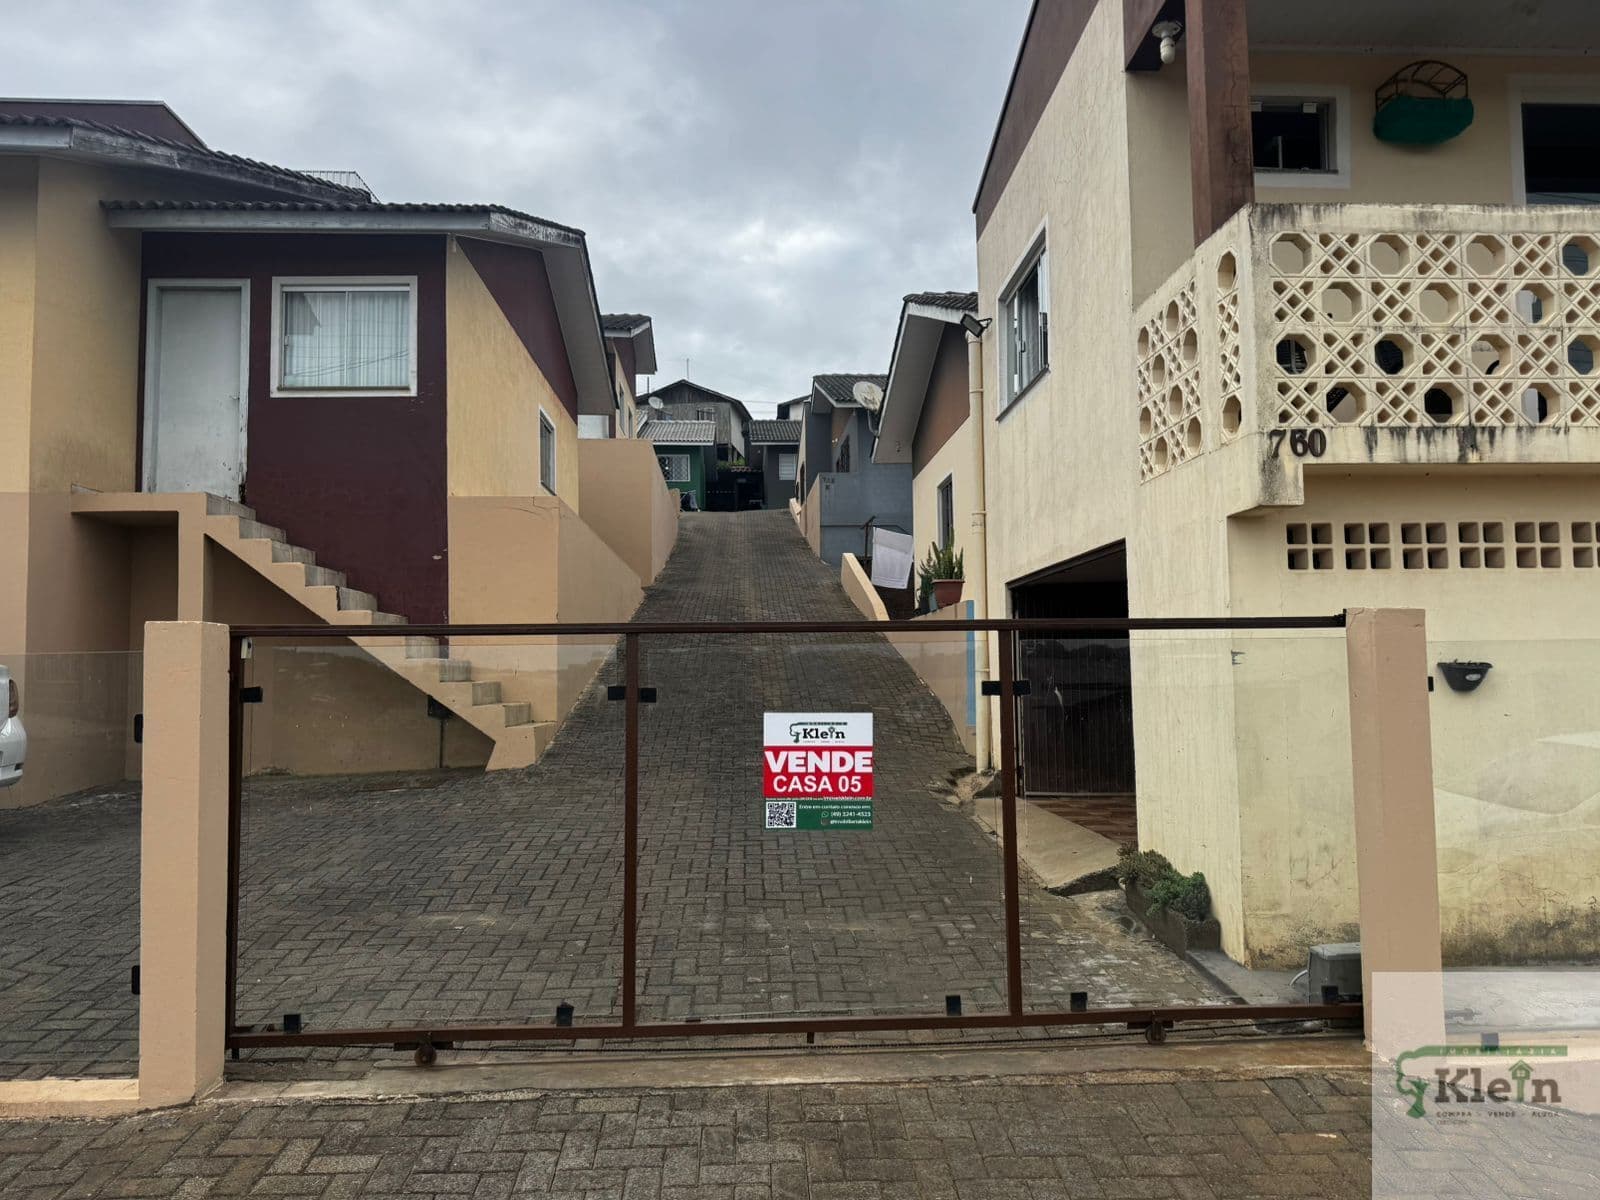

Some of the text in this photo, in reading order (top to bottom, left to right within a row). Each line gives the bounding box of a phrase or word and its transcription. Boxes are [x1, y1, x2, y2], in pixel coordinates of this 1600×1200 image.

[802, 726, 846, 739] Klein
[763, 750, 874, 774] VENDE
[773, 775, 862, 793] CASA 05
